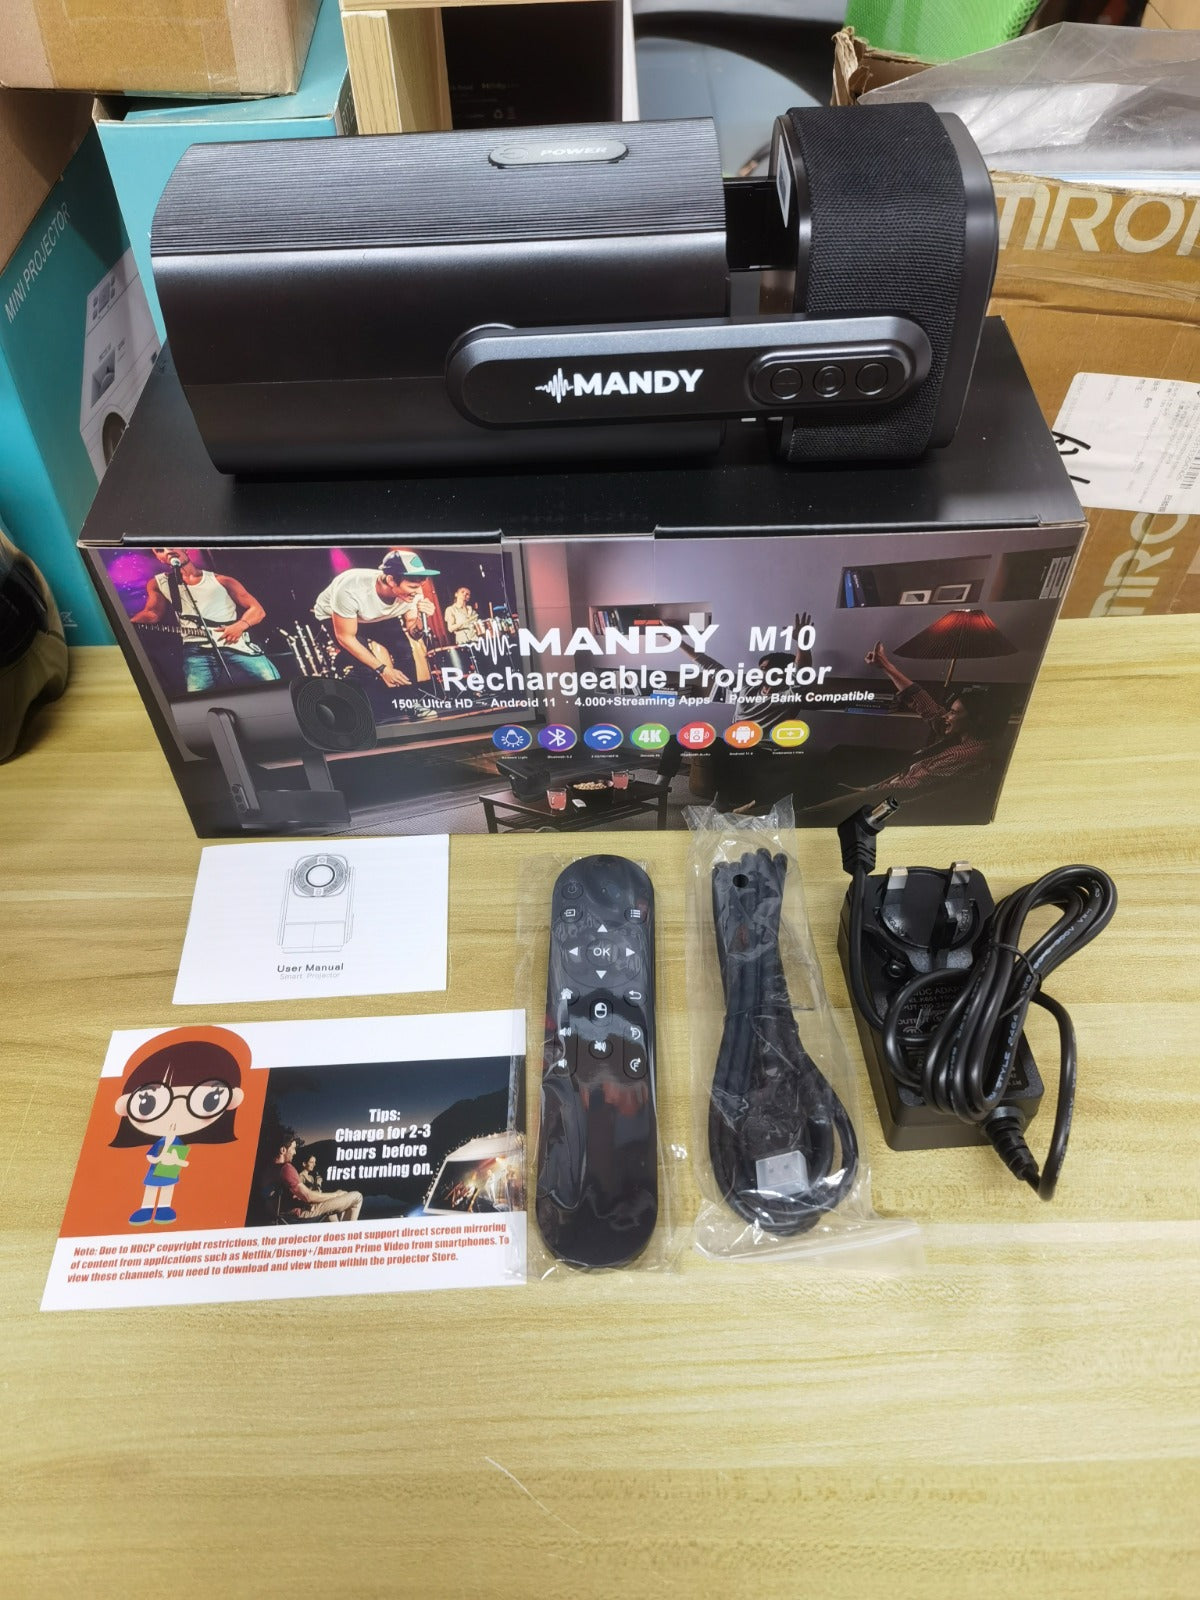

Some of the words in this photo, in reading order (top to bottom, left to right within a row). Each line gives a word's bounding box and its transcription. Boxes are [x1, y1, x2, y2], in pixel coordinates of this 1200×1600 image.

[990, 182, 1200, 256] MRO
[4, 279, 27, 324] MINI
[23, 201, 71, 291] PROJECTOR
[573, 369, 703, 397] MANDY
[517, 623, 720, 656] MANDY
[749, 624, 817, 652] M10
[441, 664, 667, 695] Rechargeable
[679, 663, 832, 692] Projector
[422, 699, 452, 708] Ultra
[455, 698, 473, 708] HD
[490, 697, 539, 708] Android
[543, 697, 556, 707] 11
[574, 695, 675, 708] 4.000+Streaming
[678, 695, 711, 706] Apps
[729, 693, 768, 704] Power
[770, 692, 802, 703] Bank
[805, 691, 875, 704] Compatible
[638, 729, 662, 743] 4K
[593, 947, 611, 957] OK
[277, 964, 301, 973] User
[305, 963, 344, 972] Manual
[306, 971, 340, 980] Projector
[369, 1108, 401, 1124] Tips:
[335, 1127, 384, 1143] Charge
[387, 1125, 406, 1140] for
[409, 1124, 432, 1139] 2-3
[336, 1146, 377, 1162] hours
[381, 1143, 428, 1159] before
[326, 1165, 356, 1181] first
[358, 1163, 409, 1180] turning
[412, 1162, 434, 1176] on.
[74, 1247, 98, 1256] Note:
[99, 1245, 117, 1255] Due
[119, 1245, 128, 1254] to
[130, 1243, 155, 1253] HDCP
[156, 1241, 202, 1252] copyright
[203, 1238, 260, 1249] restrictions,
[261, 1236, 276, 1246] the
[278, 1234, 321, 1246] projector
[323, 1232, 346, 1242] does
[347, 1231, 362, 1240] not
[364, 1229, 400, 1240] support
[401, 1227, 429, 1238] direct
[430, 1225, 462, 1236] screen
[463, 1222, 507, 1234] mirroring
[70, 1260, 80, 1270] of
[81, 1258, 118, 1269] content
[119, 1257, 142, 1267] from
[143, 1254, 202, 1267] applications
[204, 1252, 227, 1262] such
[229, 1252, 240, 1261] as
[241, 1245, 353, 1260] Netflix/Disney+/Amazon
[355, 1243, 382, 1253] Prime
[383, 1241, 410, 1251] Video
[411, 1240, 432, 1250] from
[435, 1236, 497, 1248] smartphones.
[499, 1235, 510, 1245] To
[67, 1273, 89, 1283] view
[91, 1271, 117, 1282] these
[119, 1268, 165, 1280] channels,
[167, 1269, 184, 1279] you
[186, 1266, 209, 1276] need
[211, 1266, 221, 1275] to
[222, 1262, 269, 1275] download
[270, 1262, 288, 1272] and
[290, 1260, 312, 1271] view
[313, 1259, 337, 1269] them
[339, 1257, 368, 1267] within
[370, 1255, 385, 1265] the
[386, 1253, 430, 1265] projector
[431, 1252, 458, 1262] Store.
